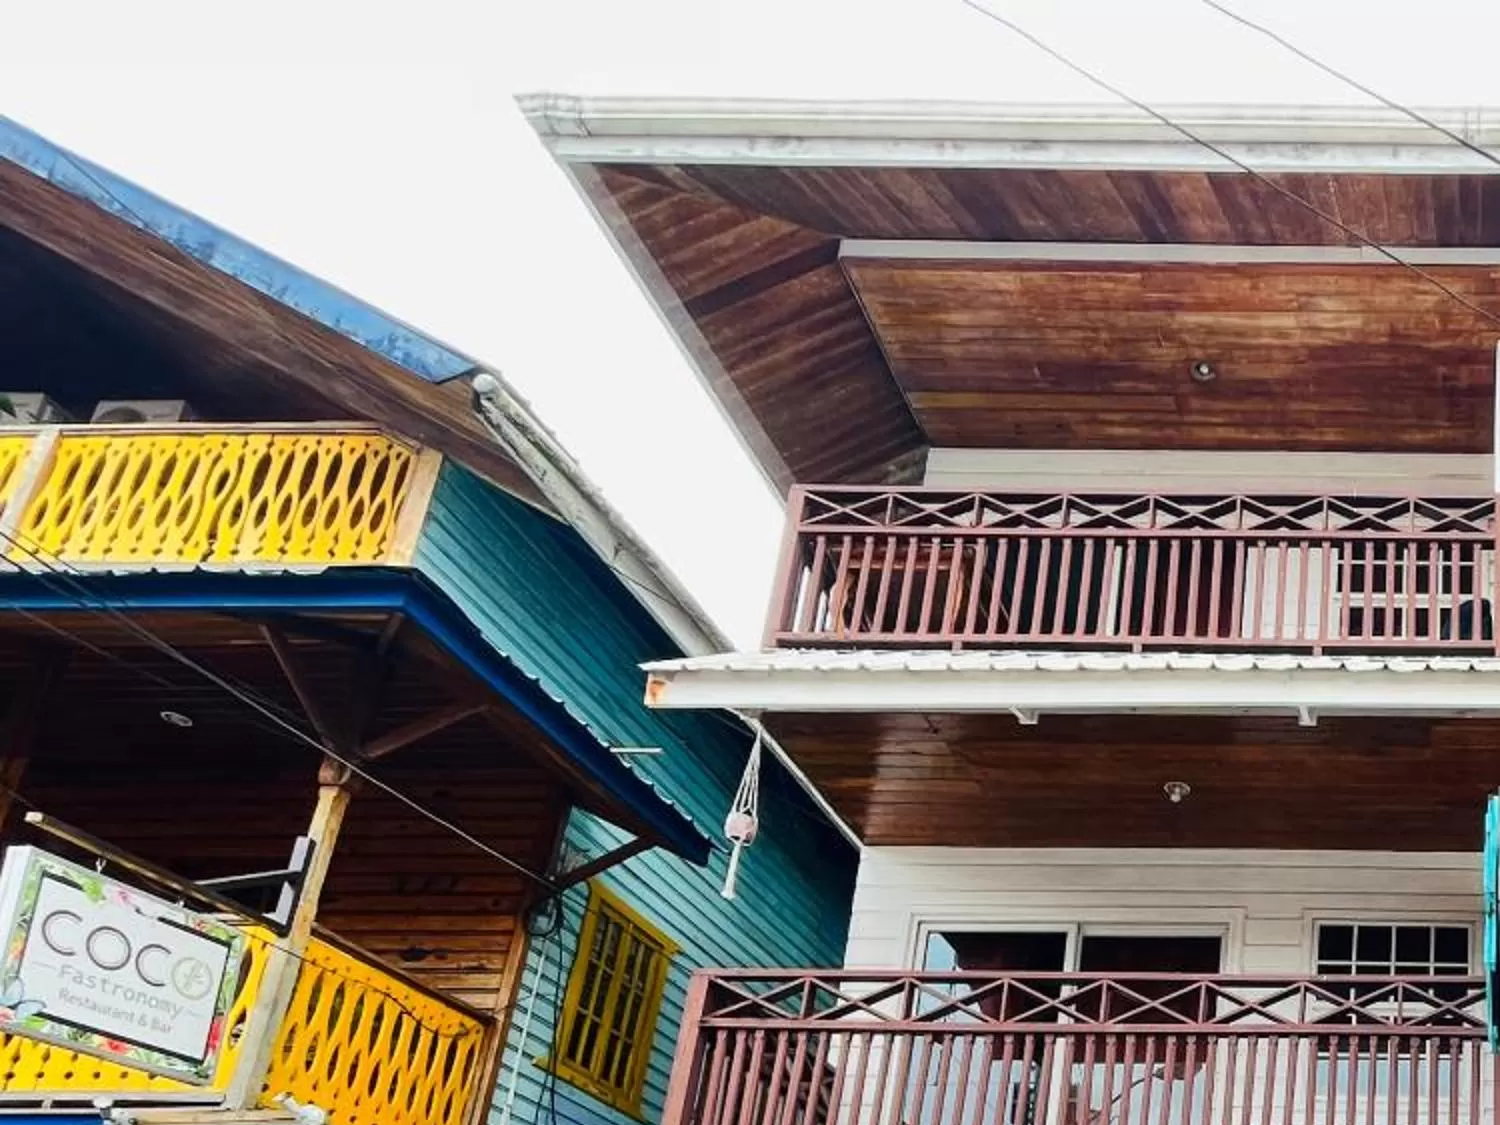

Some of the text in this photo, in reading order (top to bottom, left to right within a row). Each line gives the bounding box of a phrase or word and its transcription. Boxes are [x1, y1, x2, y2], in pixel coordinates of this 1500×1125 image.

[58, 987, 135, 1023] Restaurant
[151, 1014, 174, 1034] Bar
[59, 964, 185, 1018] Fastronomy
